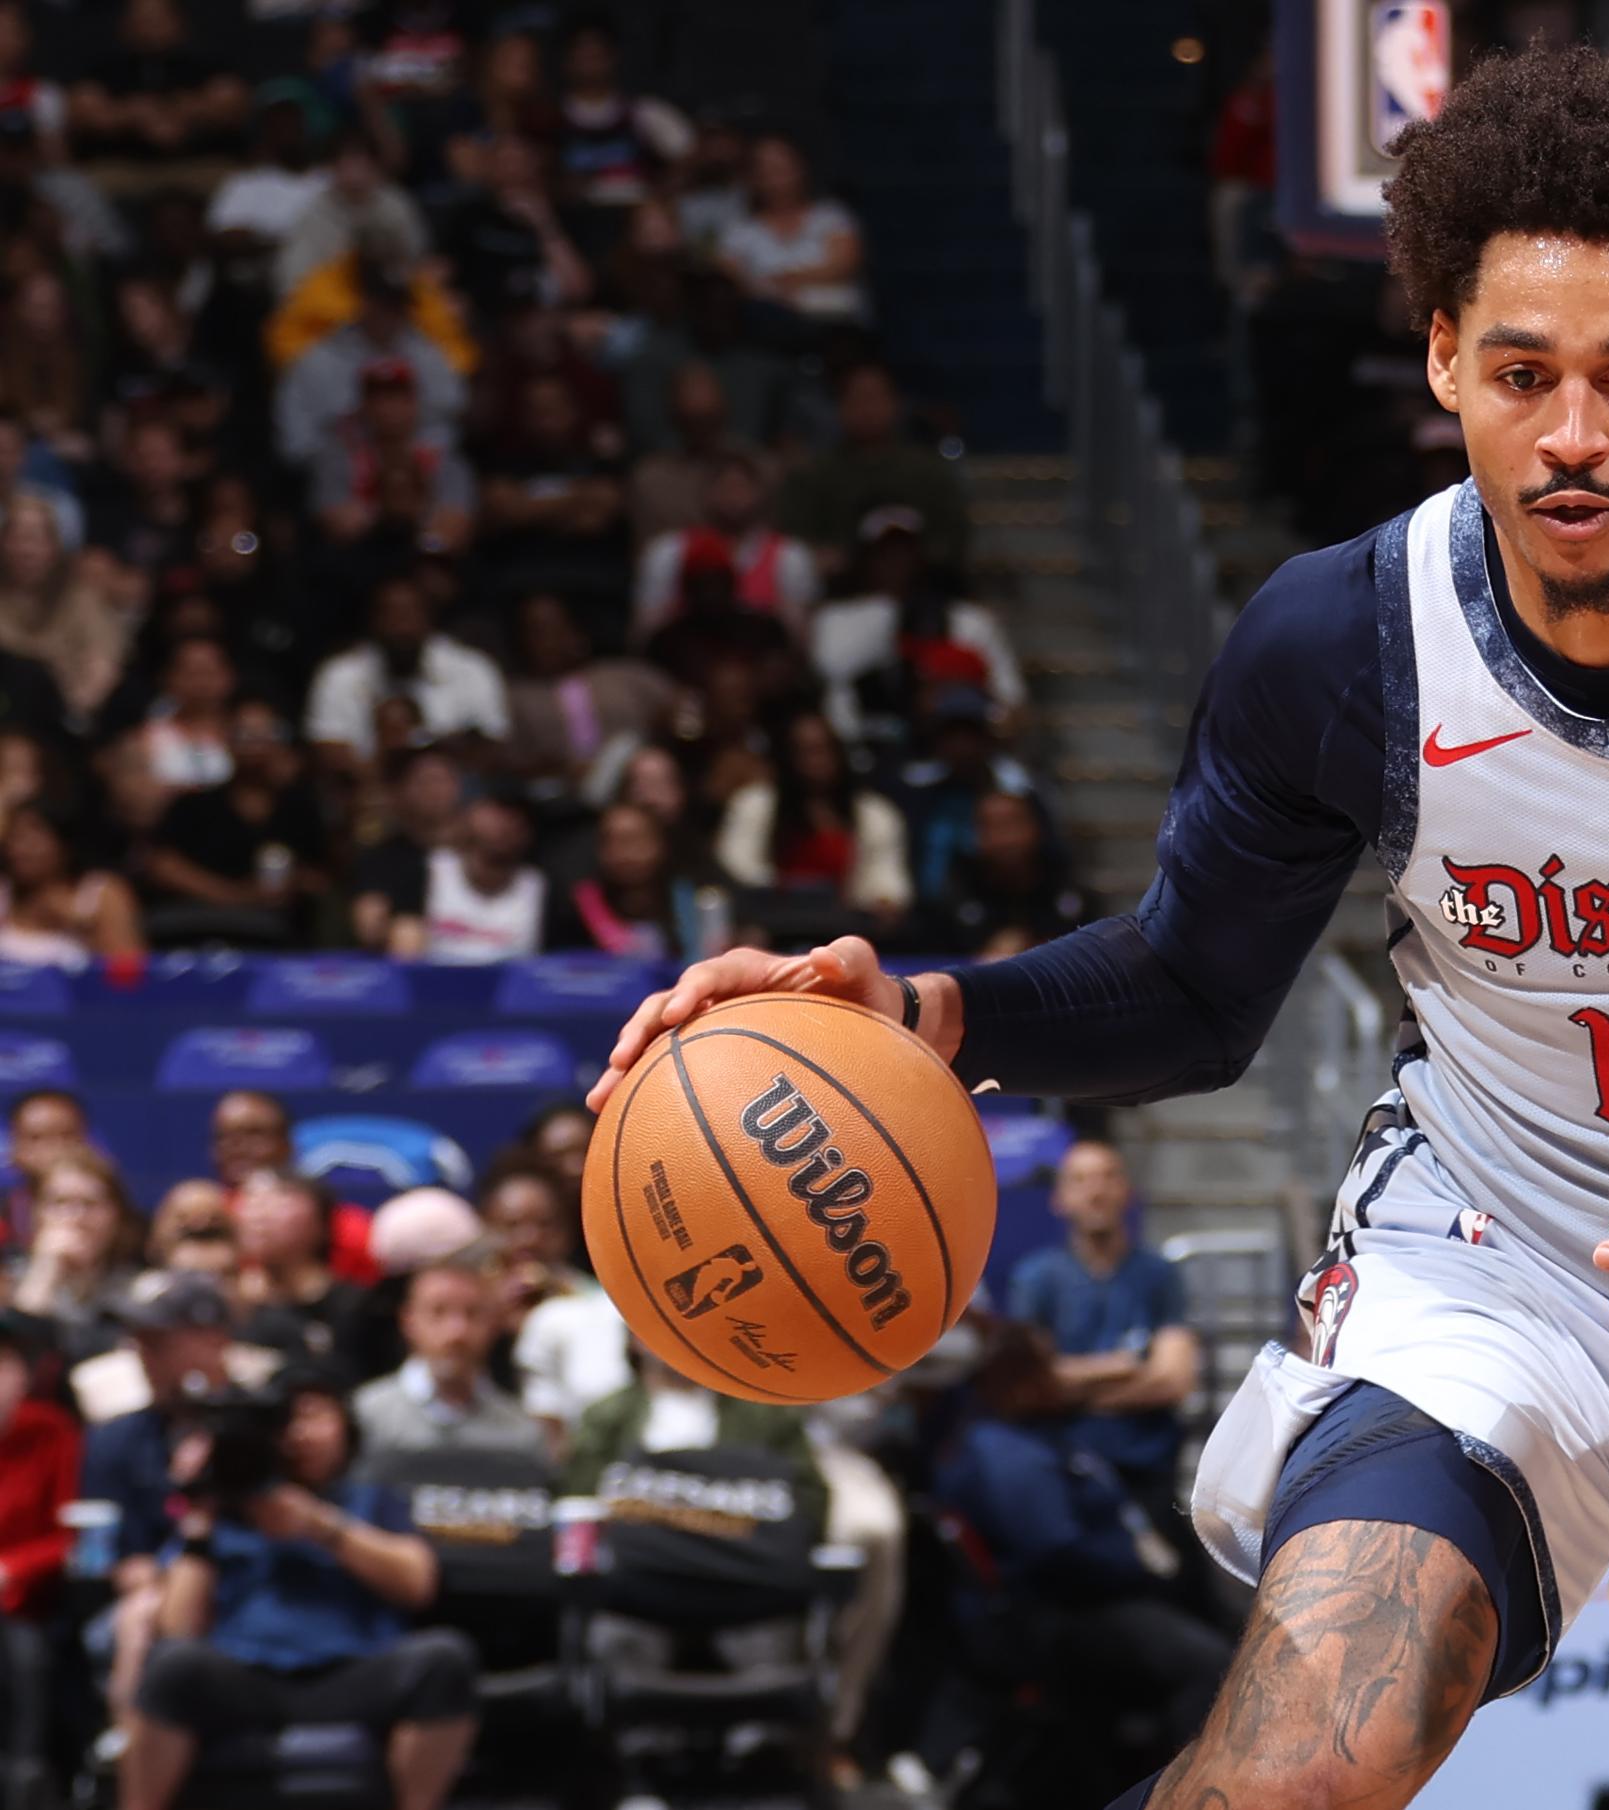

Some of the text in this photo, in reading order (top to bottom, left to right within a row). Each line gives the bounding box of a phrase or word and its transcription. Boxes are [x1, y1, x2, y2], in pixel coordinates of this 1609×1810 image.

[1440, 886, 1505, 928] the
[1485, 958, 1526, 976] OF
[740, 1072, 912, 1332] Wilson
[662, 1200, 684, 1229] GAME
[673, 1226, 694, 1251] BALL
